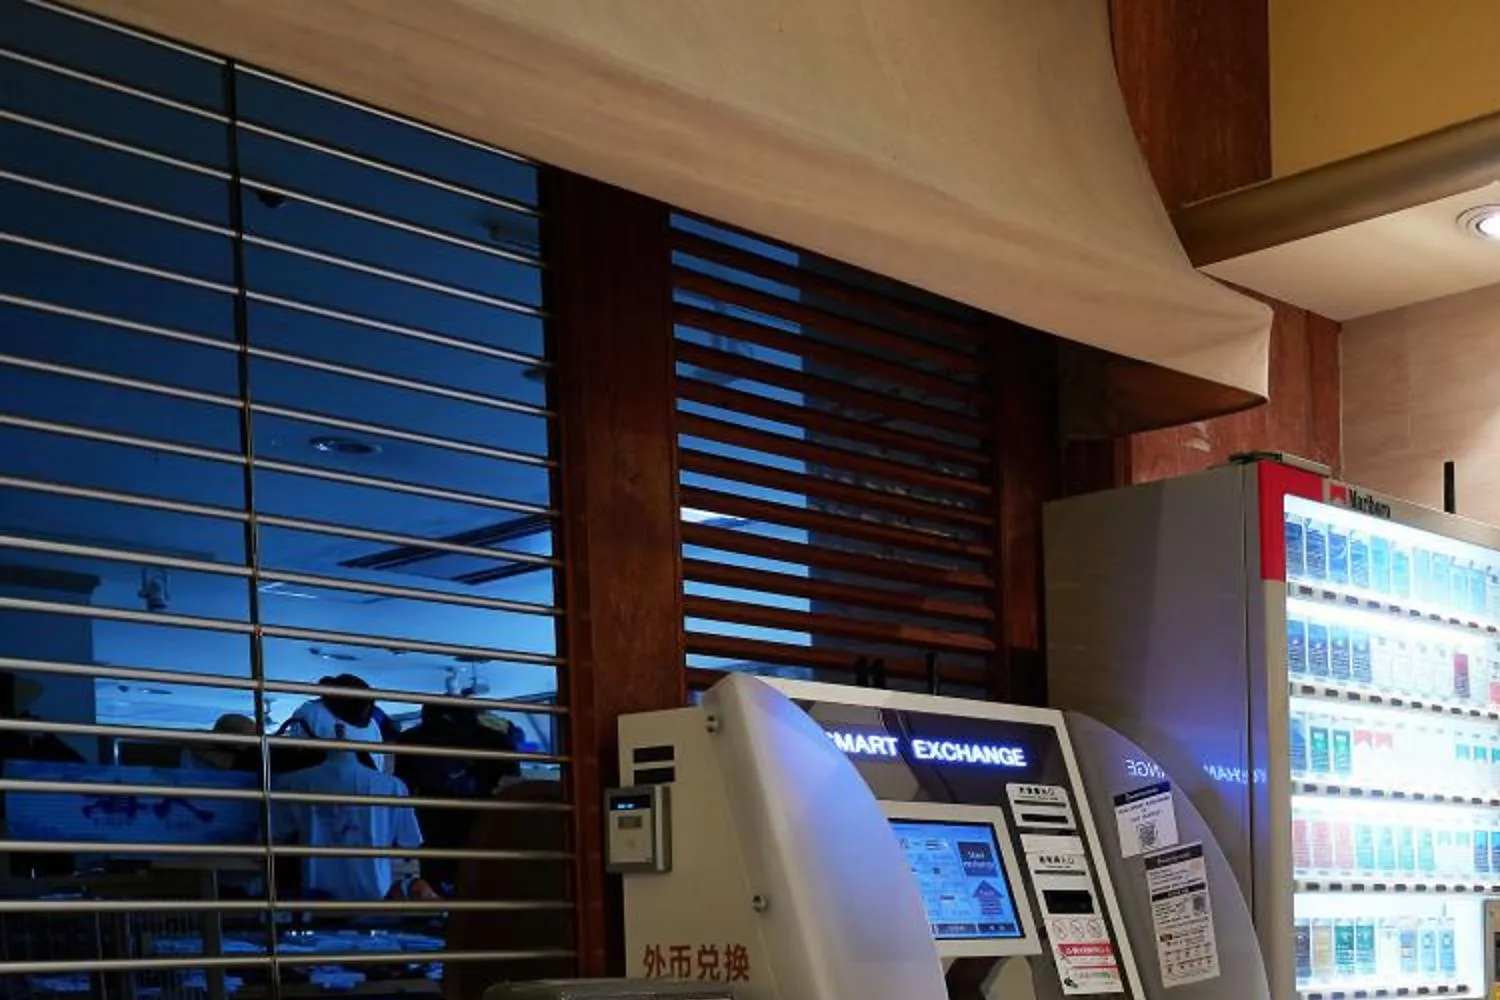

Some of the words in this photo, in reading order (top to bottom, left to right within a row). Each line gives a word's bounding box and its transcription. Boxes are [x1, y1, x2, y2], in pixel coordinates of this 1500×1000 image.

[826, 732, 898, 757] MART
[911, 739, 1028, 767] EXCHANGE
[643, 943, 751, 982] 外币兑换
